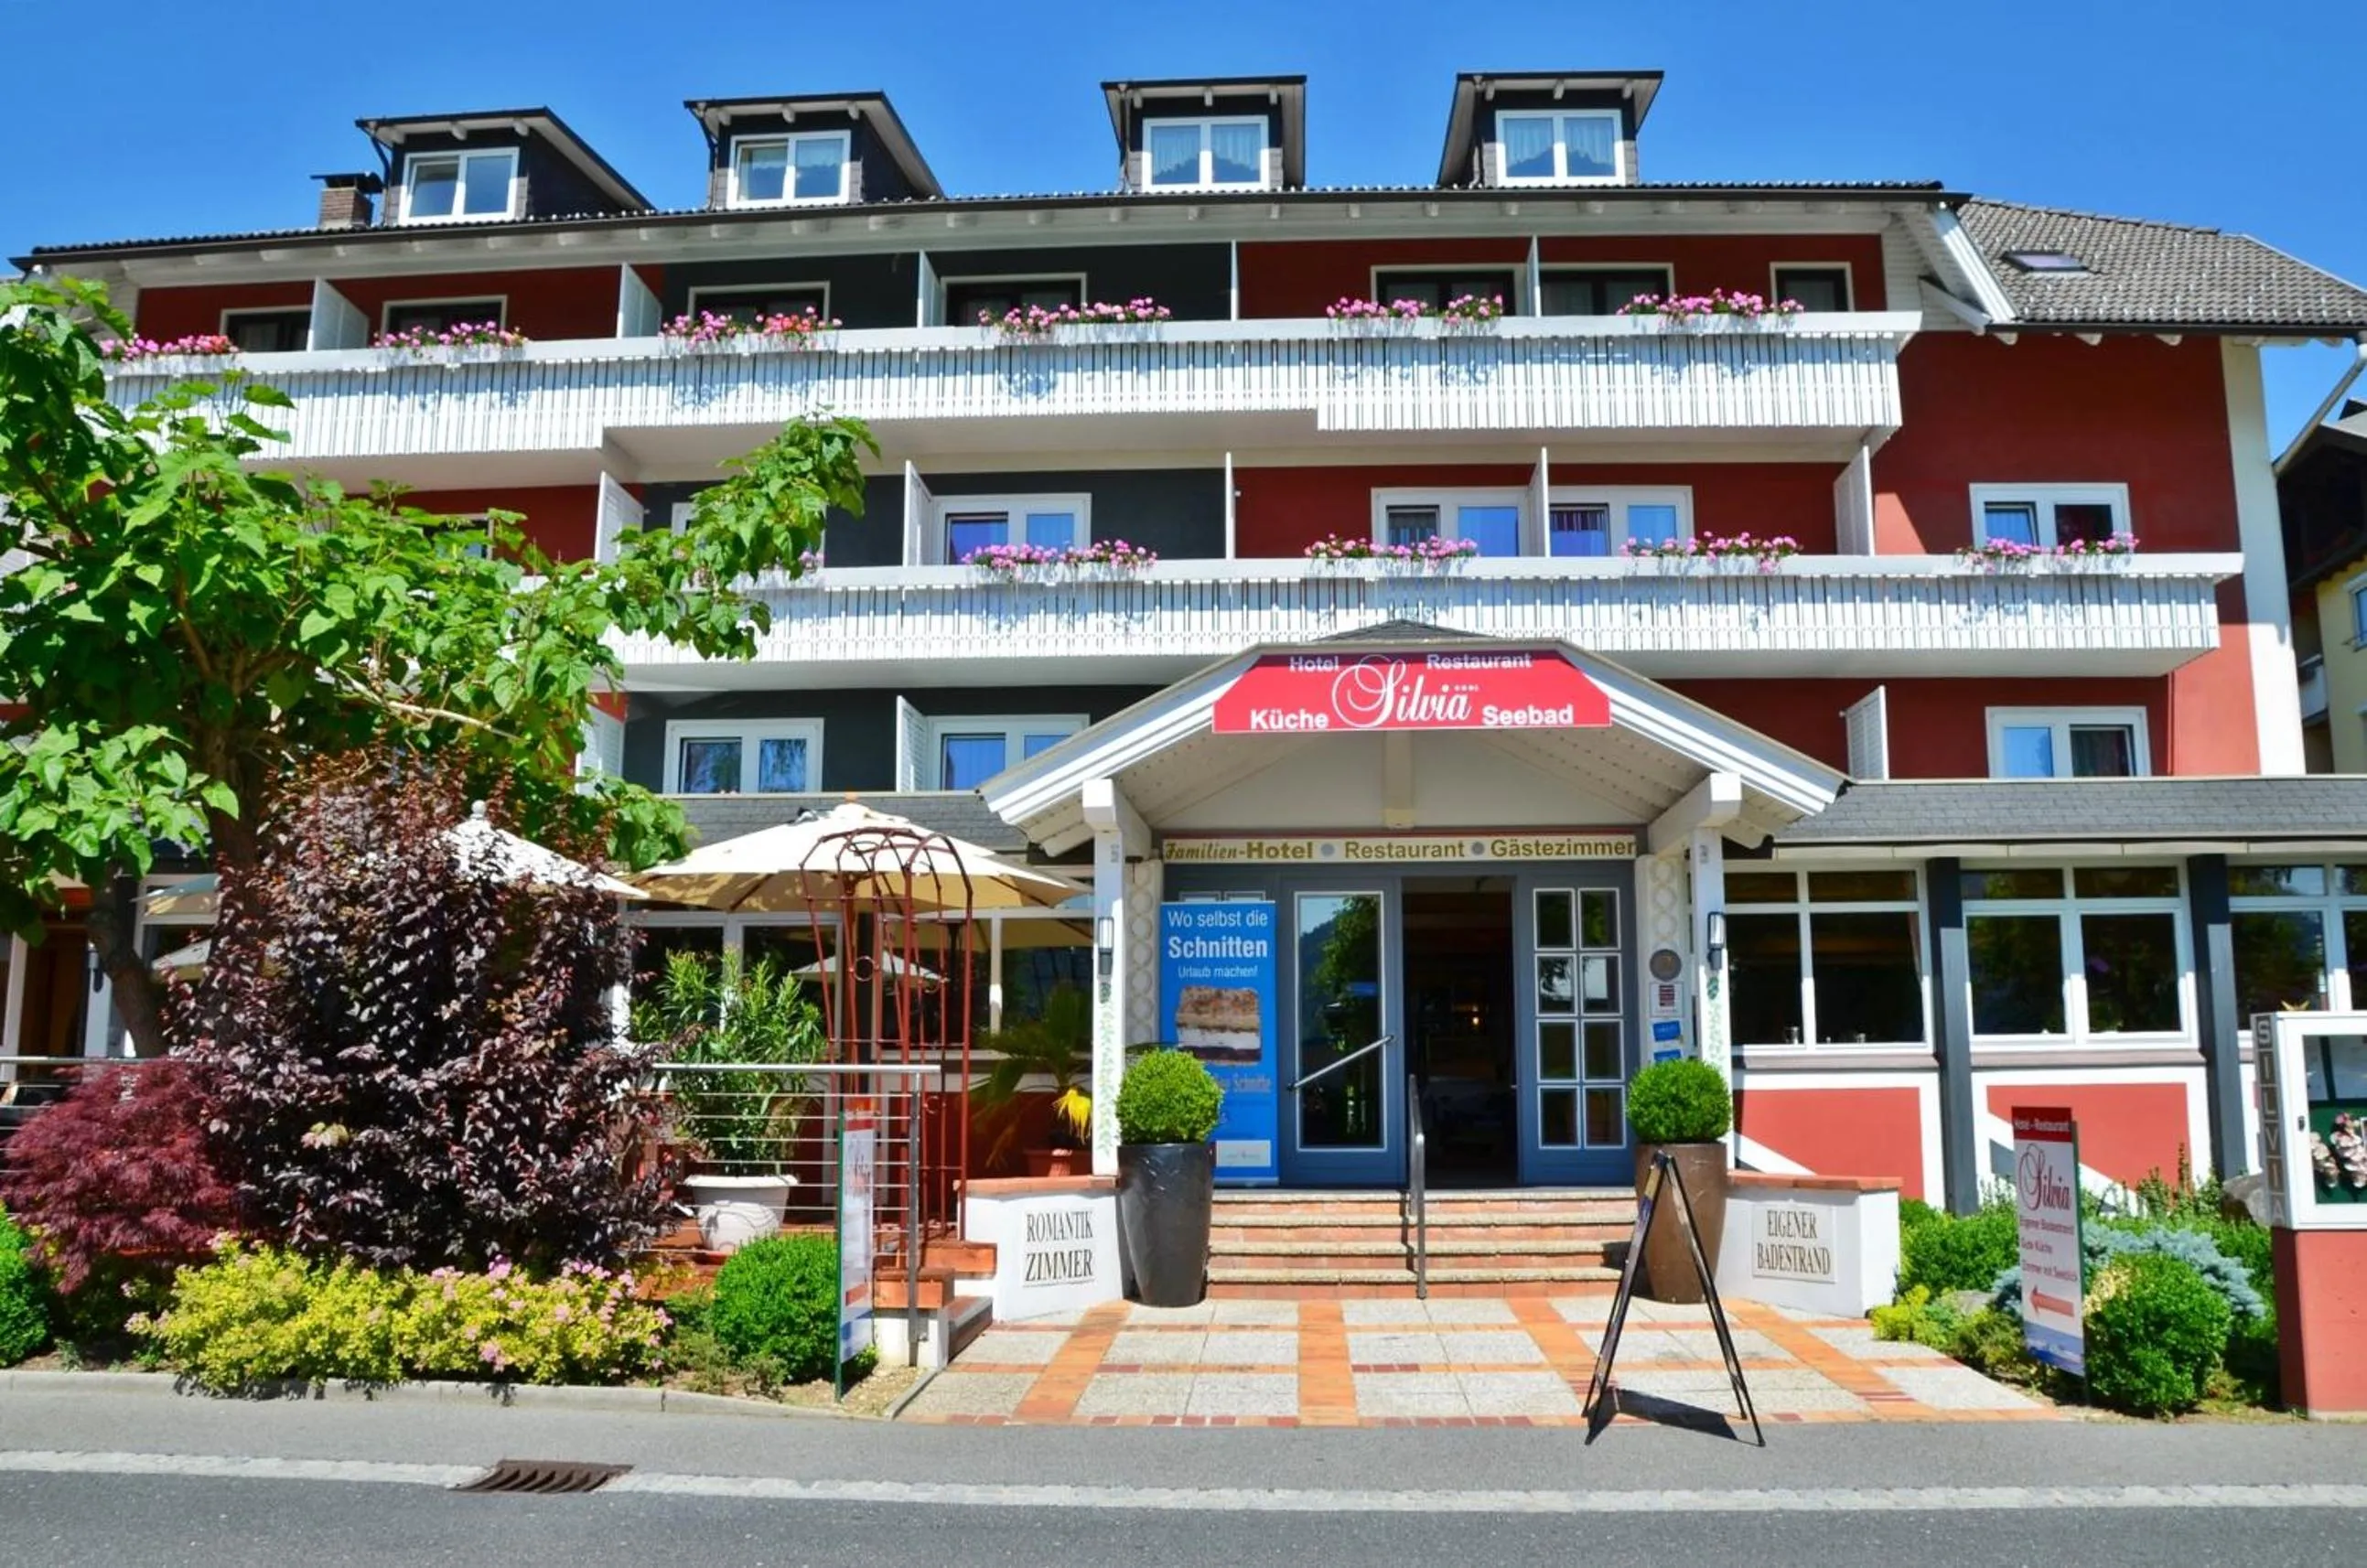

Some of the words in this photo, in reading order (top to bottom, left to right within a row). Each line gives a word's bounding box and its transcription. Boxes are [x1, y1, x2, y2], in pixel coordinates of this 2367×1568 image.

[1289, 655, 1340, 673] Hotel
[1426, 652, 1533, 671] Restaurant
[1331, 653, 1471, 728] Silvia
[1250, 708, 1329, 731] Küche
[1481, 703, 1575, 726] Seebad
[1344, 840, 1465, 860] Restaurant
[1490, 837, 1638, 858] Gästezimmer
[1167, 910, 1193, 928] Wo
[1197, 910, 1242, 928] selbst
[1245, 909, 1269, 928] die
[1167, 936, 1269, 959] Schnitten
[1178, 966, 1212, 979] Urlaub
[2256, 1019, 2286, 1223] SILVIA
[2018, 1143, 2071, 1212] Silvia
[1026, 1210, 1094, 1243] ROMANTIK
[1766, 1209, 1818, 1240] EIGENER
[1025, 1248, 1094, 1283] ZIMMER
[1757, 1241, 1832, 1276] BADESTRAND
